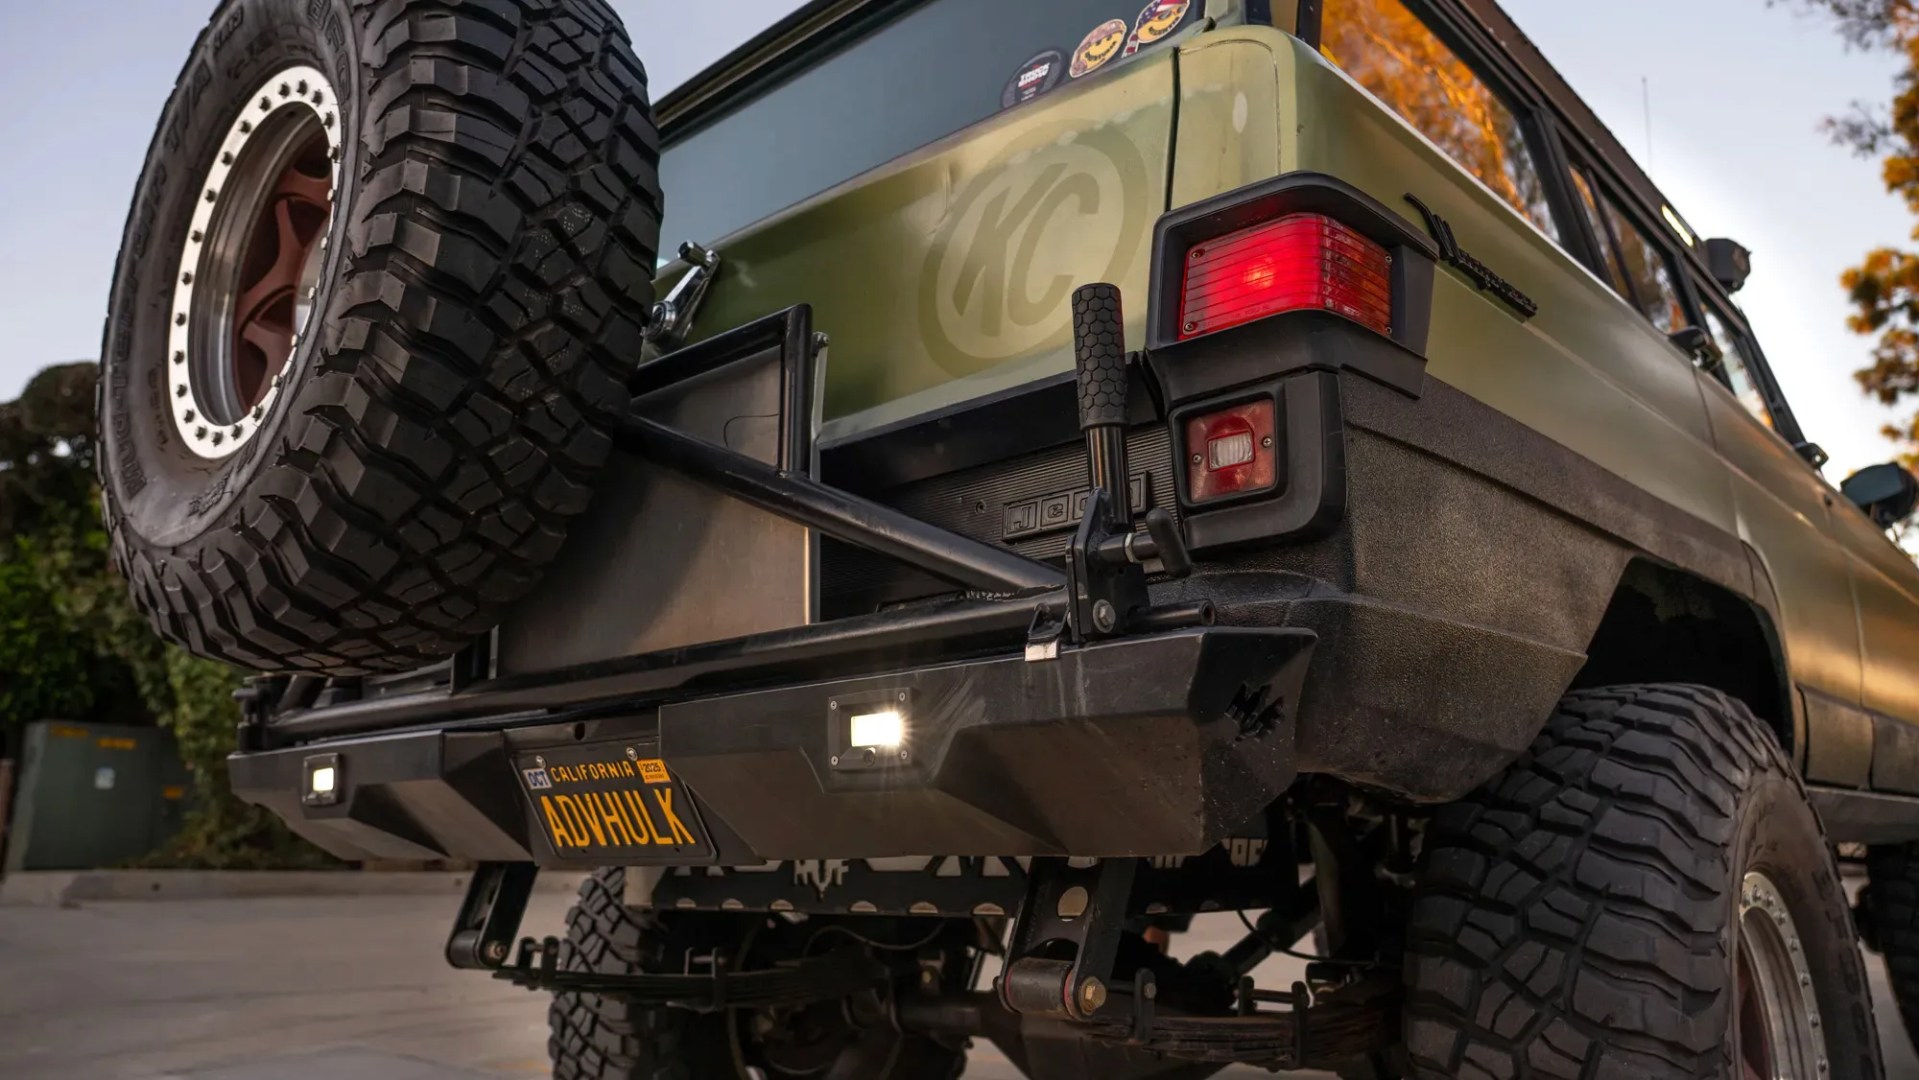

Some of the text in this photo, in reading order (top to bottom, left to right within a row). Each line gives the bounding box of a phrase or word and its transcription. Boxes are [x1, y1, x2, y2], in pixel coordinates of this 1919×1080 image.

[952, 163, 1100, 337] KC
[529, 771, 549, 787] OCT
[551, 761, 635, 782] CALIFORNIA
[541, 788, 696, 847] ADVHULK
